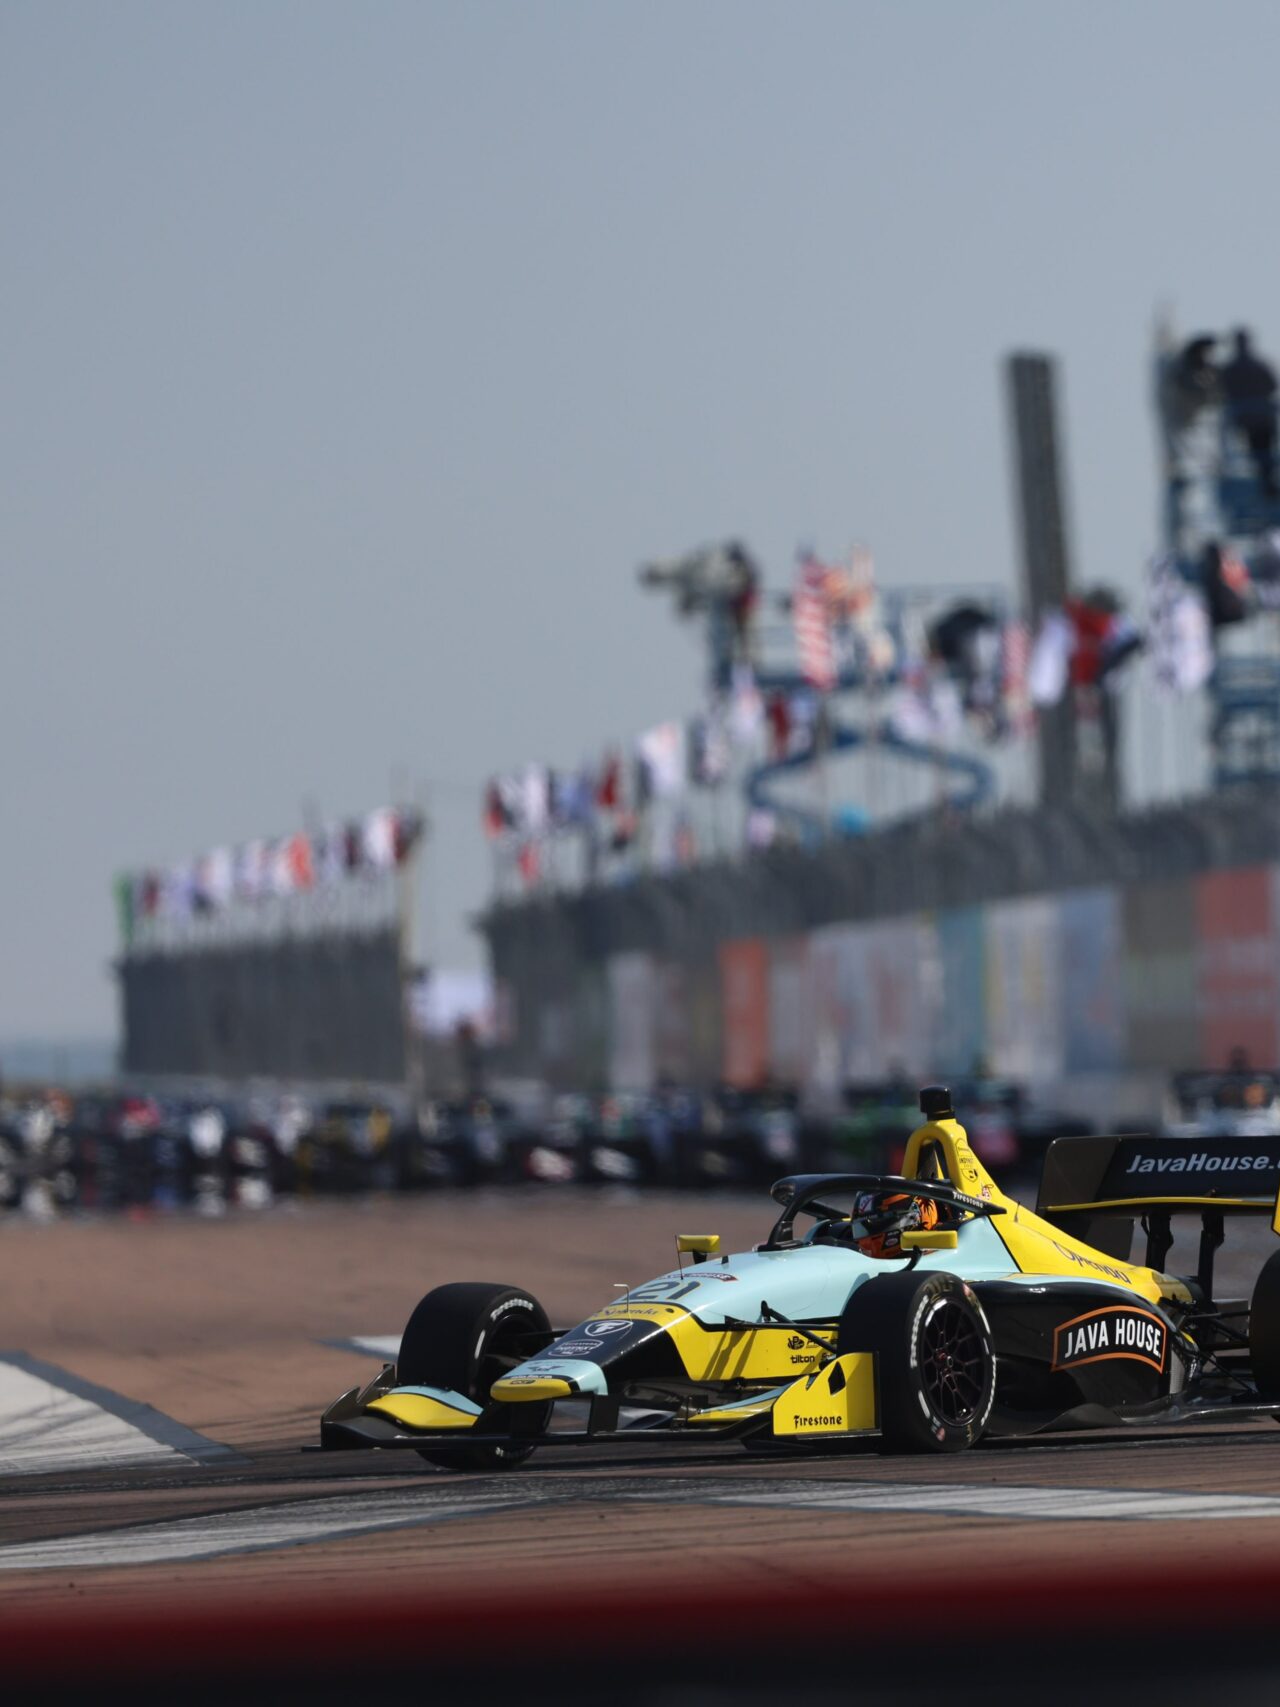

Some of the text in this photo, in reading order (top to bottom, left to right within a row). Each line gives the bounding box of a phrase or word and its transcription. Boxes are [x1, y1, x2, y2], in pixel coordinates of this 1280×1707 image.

[1064, 1318, 1162, 1359] JAVA HOUSE
[790, 1354, 816, 1364] tilton
[794, 1414, 842, 1429] Firestone
